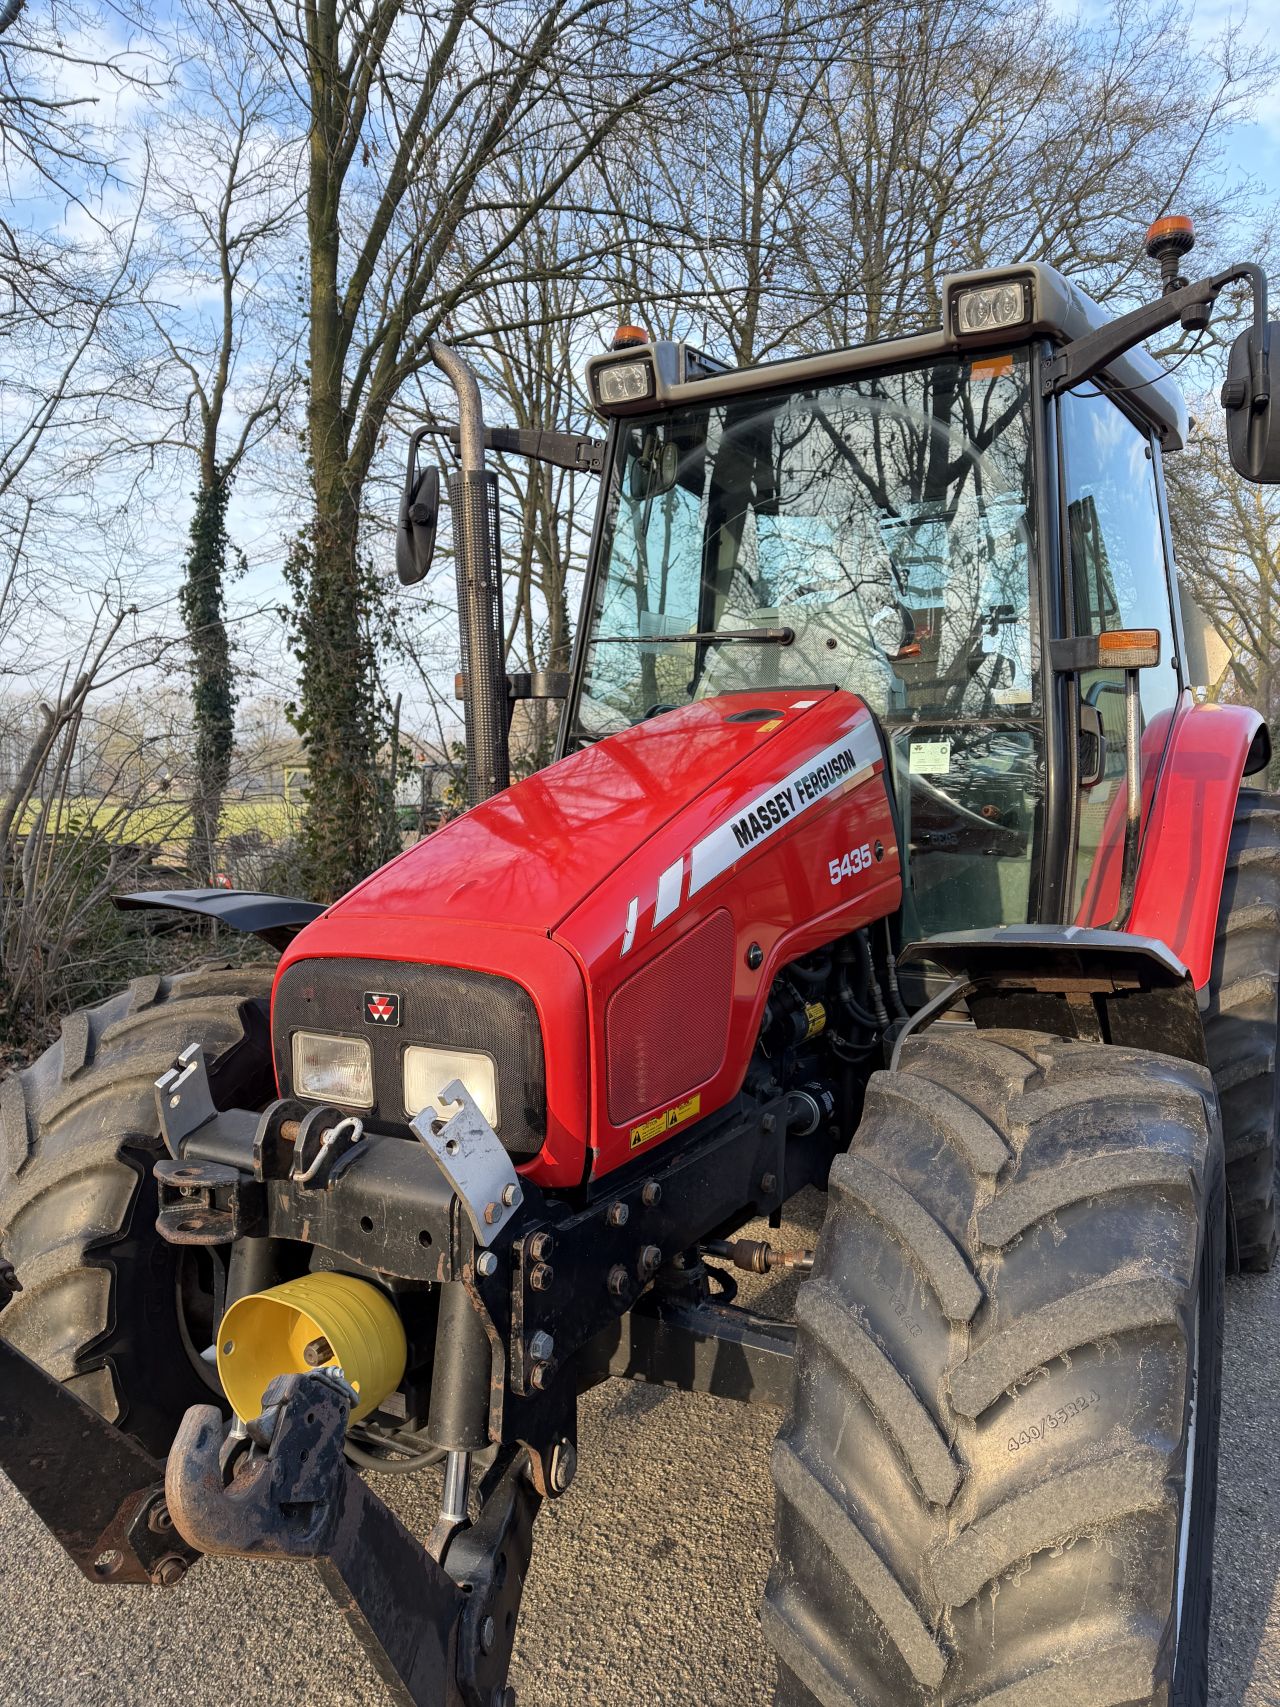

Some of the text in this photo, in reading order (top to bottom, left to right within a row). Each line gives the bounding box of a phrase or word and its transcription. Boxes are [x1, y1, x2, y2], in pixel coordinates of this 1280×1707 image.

[731, 787, 796, 848] MASSEY
[793, 748, 857, 804] FERGUSON
[828, 843, 872, 885] 5435
[1007, 1388, 1101, 1452] 440/65R24
